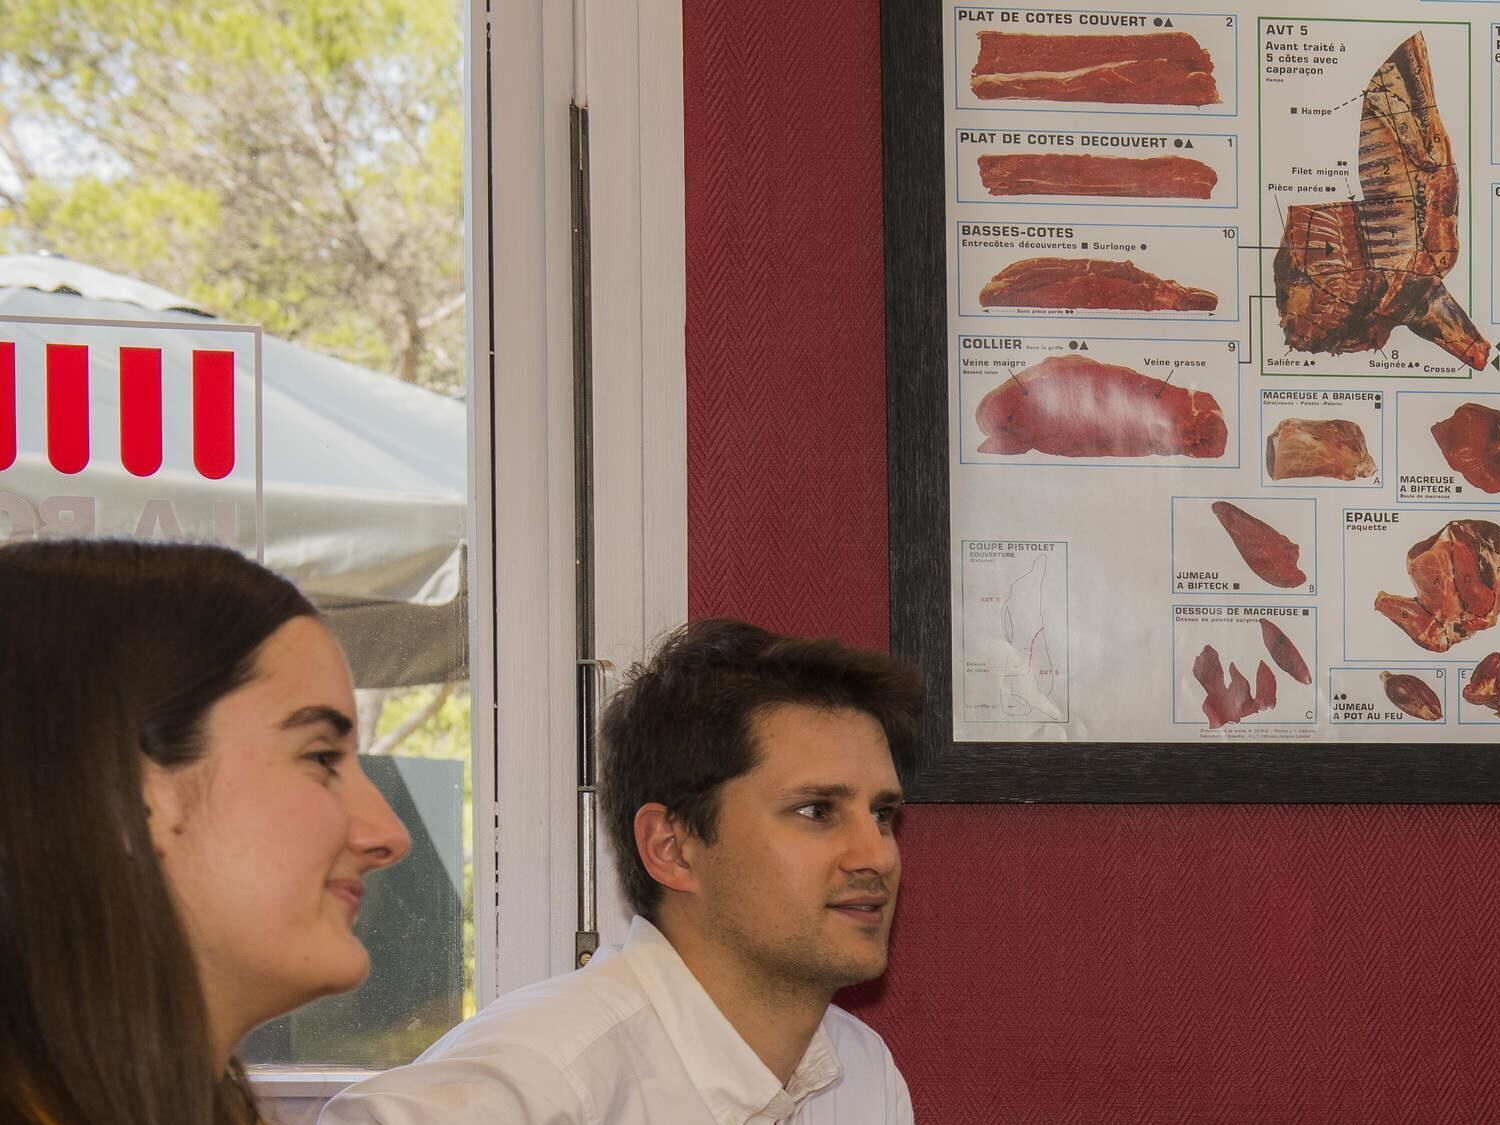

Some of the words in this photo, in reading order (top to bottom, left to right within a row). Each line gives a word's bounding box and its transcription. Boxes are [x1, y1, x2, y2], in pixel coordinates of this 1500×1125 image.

[958, 10, 995, 22] PLAT
[1001, 11, 1019, 23] DE
[1026, 12, 1072, 24] COTES
[1079, 14, 1147, 27] COUVERT
[1226, 17, 1233, 27] 2
[1266, 25, 1294, 35] AVT
[1300, 26, 1308, 36] 5
[1266, 41, 1298, 51] Avant
[1304, 42, 1335, 52] traité
[1266, 54, 1273, 62] 5
[1278, 54, 1309, 64] côtes
[1313, 56, 1338, 65] avec
[1266, 66, 1323, 76] caparaçon
[1301, 108, 1332, 117] Hampe
[960, 132, 996, 144] PLAT
[1003, 133, 1021, 144] DE
[1029, 134, 1075, 146] COTES
[1081, 136, 1168, 149] DECOUVERT
[1433, 133, 1441, 143] 6
[1316, 168, 1349, 177] mignon
[1383, 165, 1390, 175] 2
[1268, 183, 1293, 192] Pièce
[1297, 185, 1324, 193] parée
[961, 225, 1074, 239] BASSES-COTES
[1222, 228, 1235, 239] 10
[962, 239, 1015, 248] Entrecôtes
[1018, 240, 1077, 250] découvertes
[1093, 242, 1136, 252] Surlonge
[962, 338, 1022, 350] COLLIER
[1228, 343, 1235, 352] 9
[1391, 350, 1399, 359] 8
[962, 359, 989, 367] Veine
[993, 359, 1026, 368] maigre
[1144, 358, 1170, 367] Veine
[1174, 359, 1206, 369] grasse
[1267, 358, 1300, 367] Salière
[1369, 360, 1406, 369] Saignée
[1423, 365, 1456, 373] Crosse
[1263, 392, 1318, 400] MACREUSE
[1332, 393, 1374, 401] BRAISER
[1400, 476, 1455, 484] MACREUSE
[1400, 485, 1407, 493] A
[1410, 485, 1451, 493] BIFTECK
[1346, 512, 1399, 523] EPAULE
[1346, 524, 1387, 532] raquette
[969, 543, 1004, 551] COUPE
[1007, 543, 1055, 552] PISTOLET
[1176, 572, 1219, 580] JUMEAU
[1177, 582, 1184, 590] A
[1188, 582, 1229, 590] BIFTECK
[1175, 607, 1223, 615] DESSOUS
[1243, 608, 1299, 616] MACREUSE
[1436, 670, 1443, 679] D
[1461, 670, 1467, 679] E
[1333, 703, 1375, 711] JUMEAU
[1333, 712, 1340, 720] A
[1343, 712, 1363, 720] POT
[1367, 712, 1381, 720] AU
[1384, 712, 1403, 720] FEU
